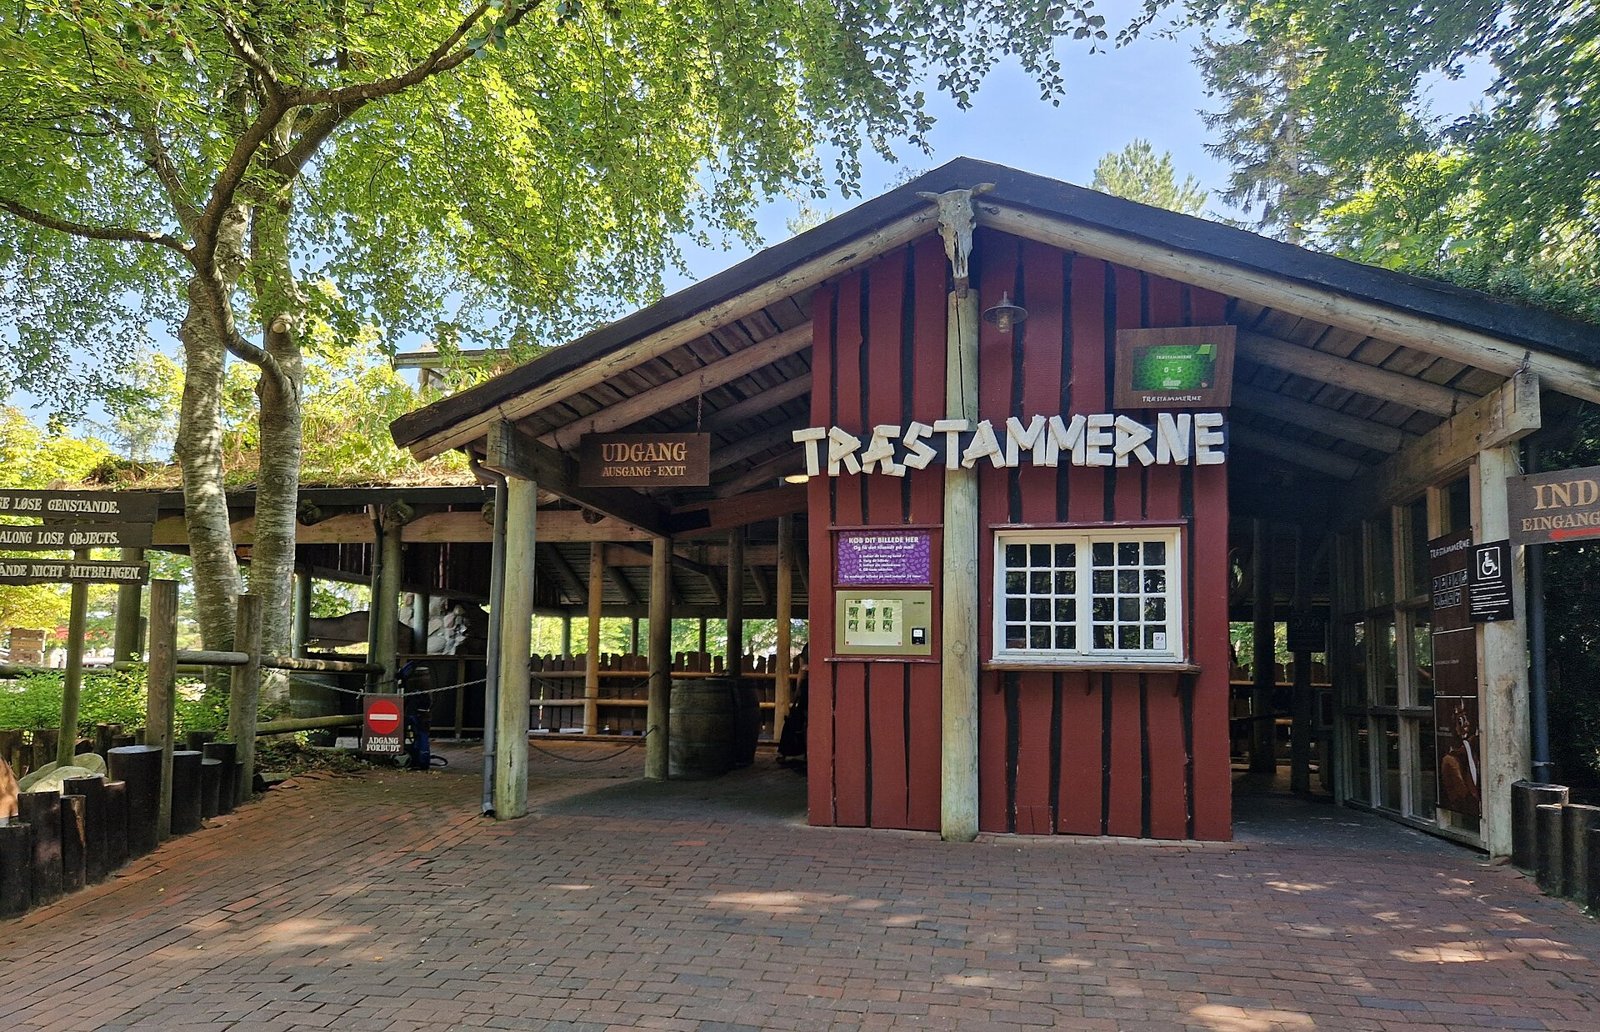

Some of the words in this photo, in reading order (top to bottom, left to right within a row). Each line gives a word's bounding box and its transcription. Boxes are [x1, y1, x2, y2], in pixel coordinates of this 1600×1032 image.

[601, 442, 688, 462] UDGANG
[792, 413, 1225, 478] TRÆSTAMMERNE
[602, 466, 651, 477] AUSGANG
[658, 465, 687, 476] EXIT
[1532, 479, 1599, 510] IND
[13, 497, 43, 511] LØSE
[47, 499, 121, 514] GENSTANDE.
[1520, 512, 1600, 532] EINGANG
[0, 530, 33, 544] ALONG
[36, 531, 64, 545] LOSE
[69, 532, 120, 545] OBJECTS.
[30, 564, 65, 578] NICHT
[69, 564, 141, 580] MITBRINGEN.
[366, 744, 401, 752] FORBUDT
[368, 736, 399, 745] ADGANG
